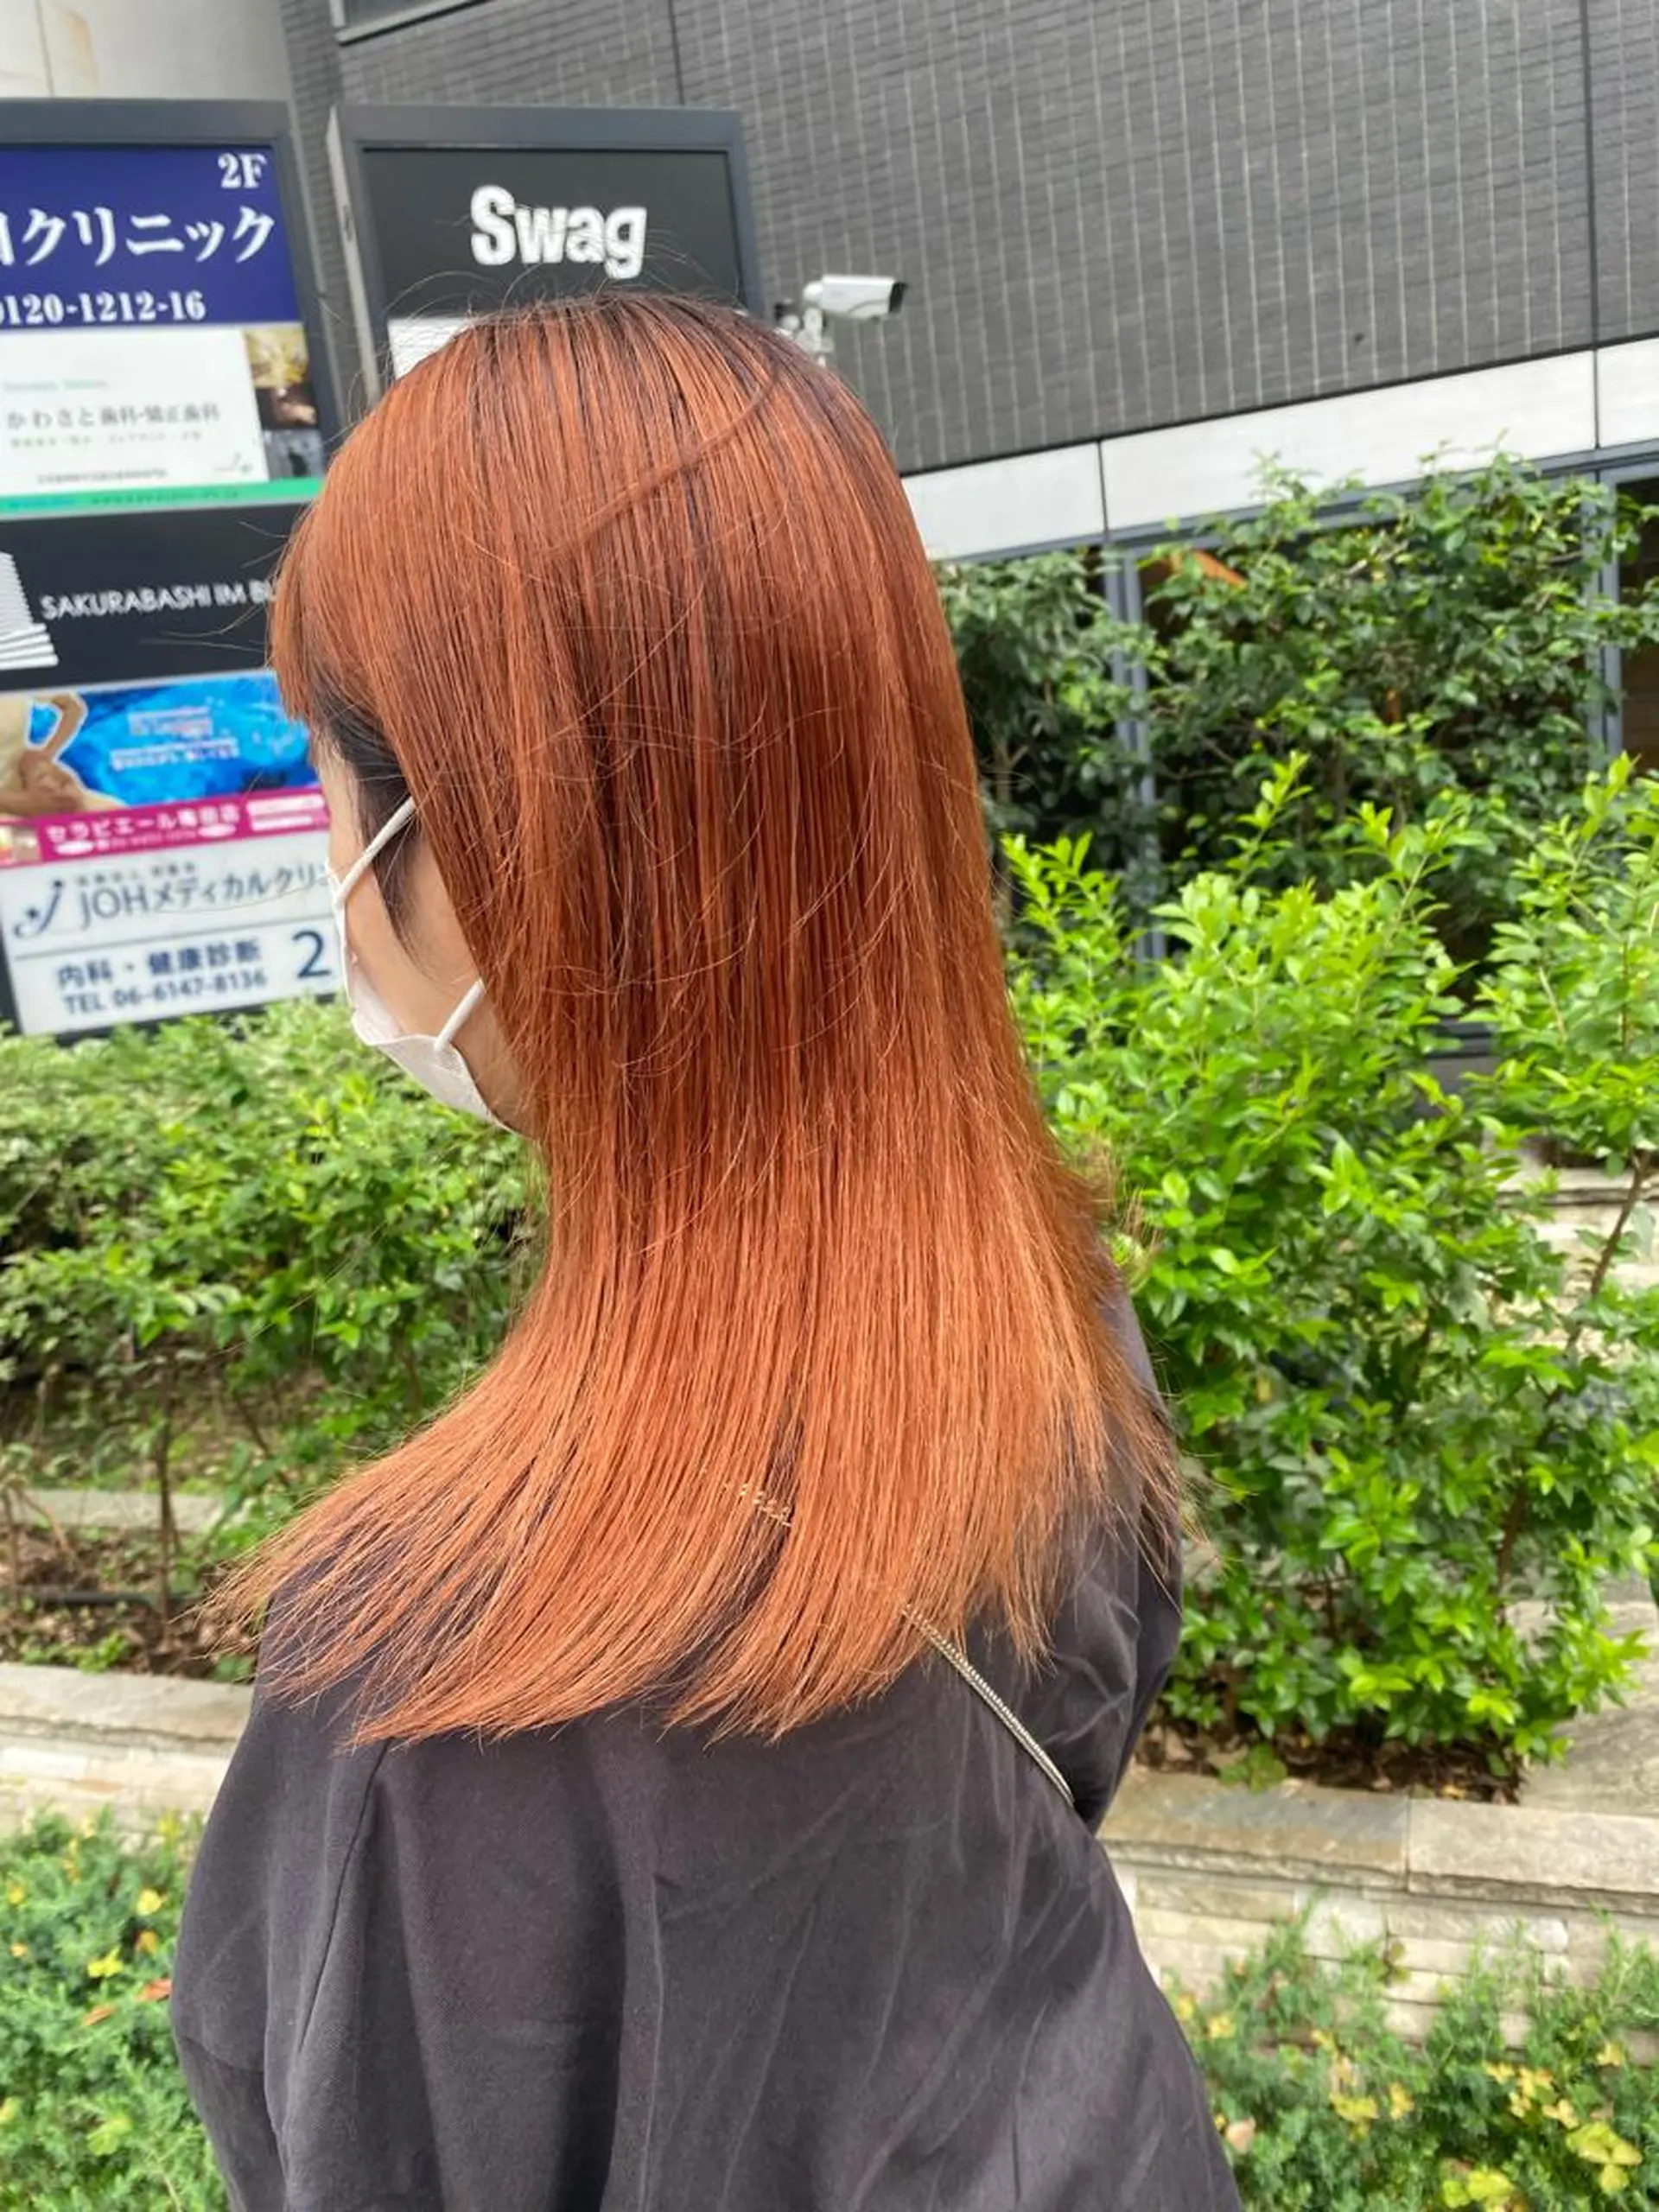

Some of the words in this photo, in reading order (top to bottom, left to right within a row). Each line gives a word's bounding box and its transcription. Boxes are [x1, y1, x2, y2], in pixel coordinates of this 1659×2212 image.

[218, 153, 266, 188] 2F
[0, 206, 276, 267] クリニック
[470, 184, 647, 279] Swag
[0, 289, 207, 326] 120-1212-16
[41, 585, 211, 620] SAKURABASHI
[291, 930, 333, 979] 2
[63, 992, 107, 1016] TEL
[112, 965, 268, 1008] 06-6147-8136
